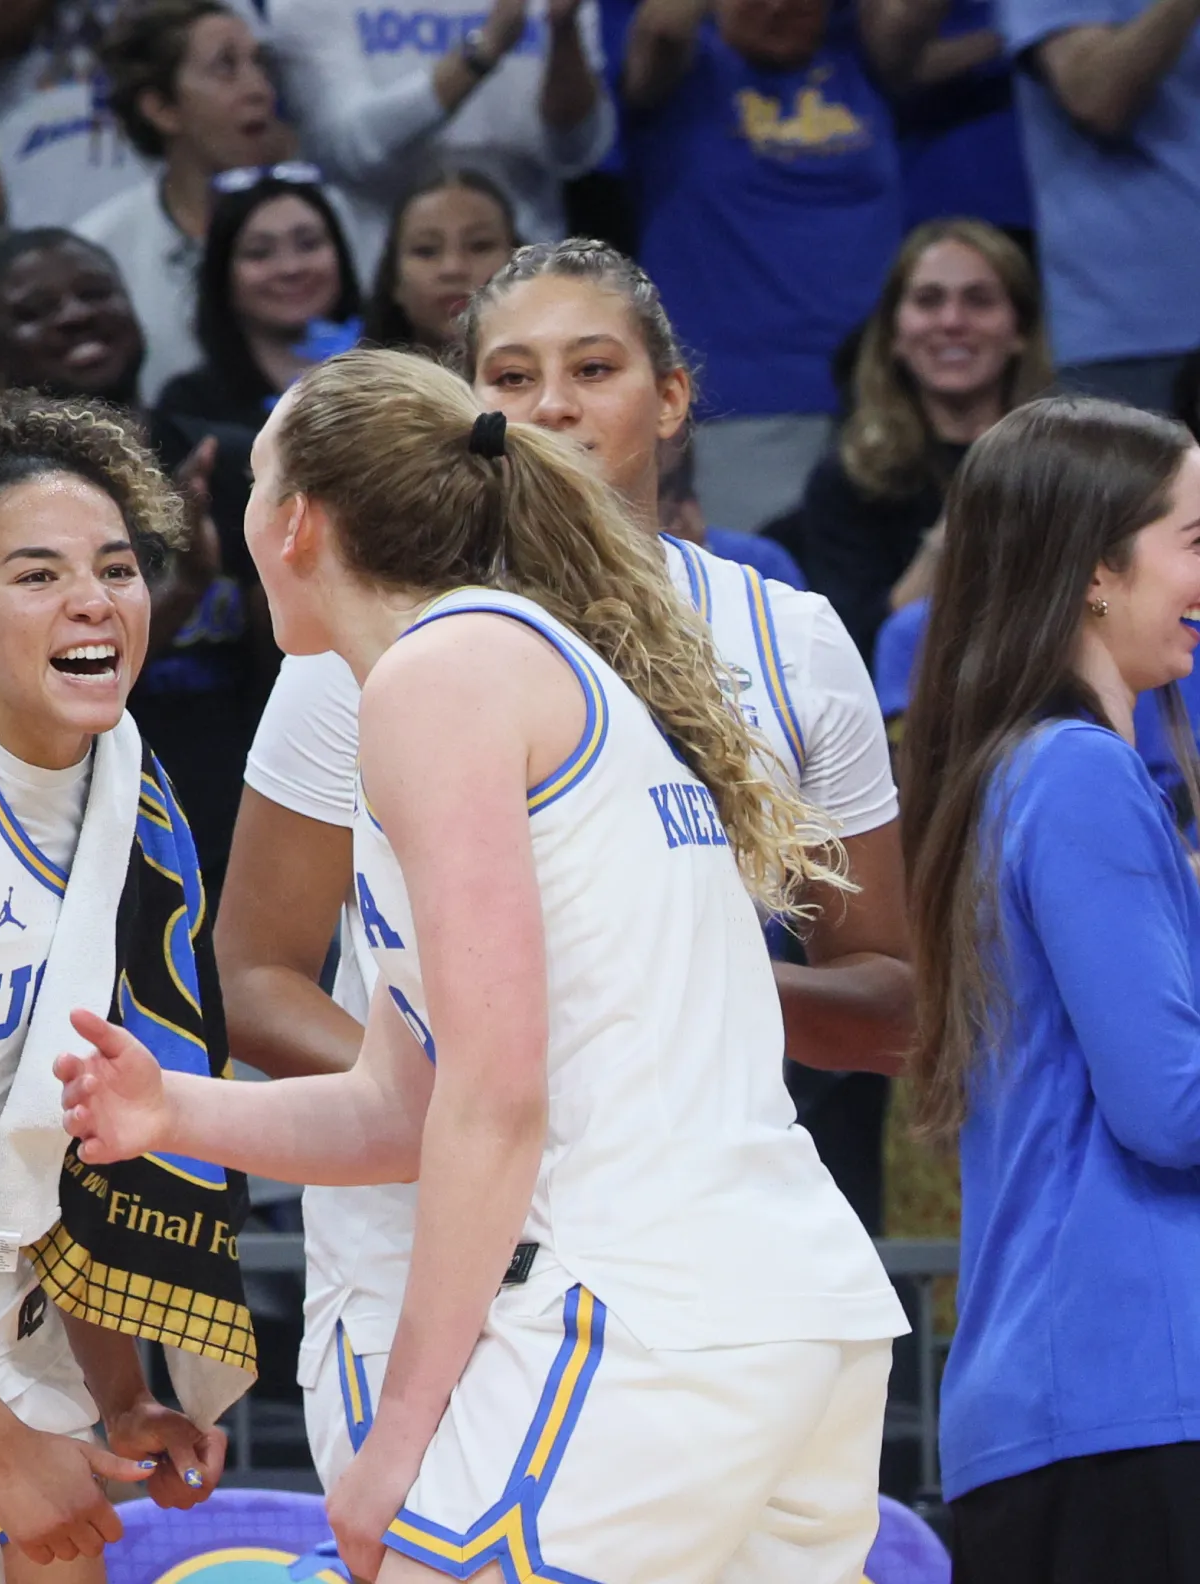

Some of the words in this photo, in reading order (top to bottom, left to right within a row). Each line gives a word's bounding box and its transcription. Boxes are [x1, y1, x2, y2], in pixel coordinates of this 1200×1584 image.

[647, 782, 728, 849] KNEE
[356, 872, 406, 950] A
[106, 1189, 204, 1248] Final
[208, 1219, 241, 1261] Fo
